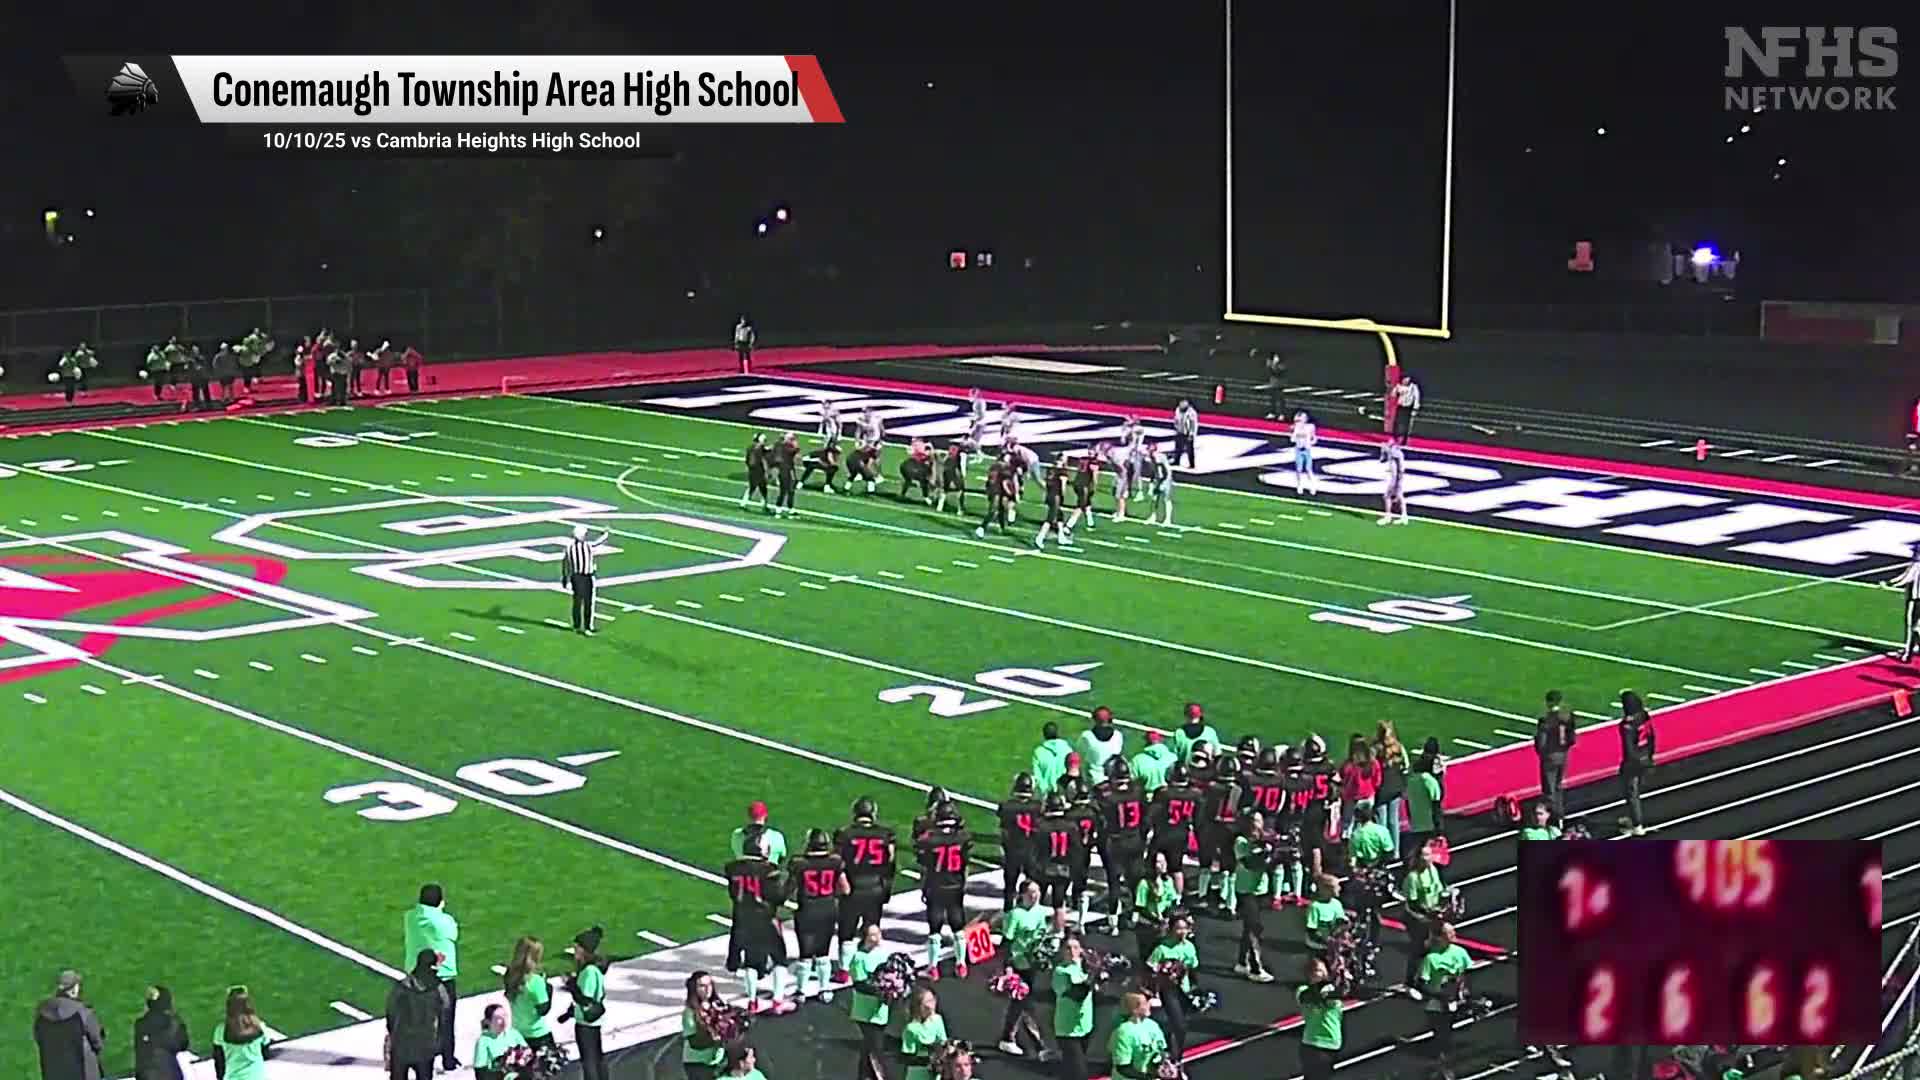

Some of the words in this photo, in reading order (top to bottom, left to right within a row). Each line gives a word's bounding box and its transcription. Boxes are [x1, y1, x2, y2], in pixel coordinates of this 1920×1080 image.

[1309, 597, 1477, 634] 10
[878, 667, 1092, 718] 20
[323, 757, 589, 821] 30
[1117, 801, 1144, 828] 13
[1167, 800, 1196, 826] 54
[851, 838, 884, 865] 75
[1050, 832, 1070, 857] 11
[932, 845, 961, 873] 76
[968, 927, 990, 957] 30
